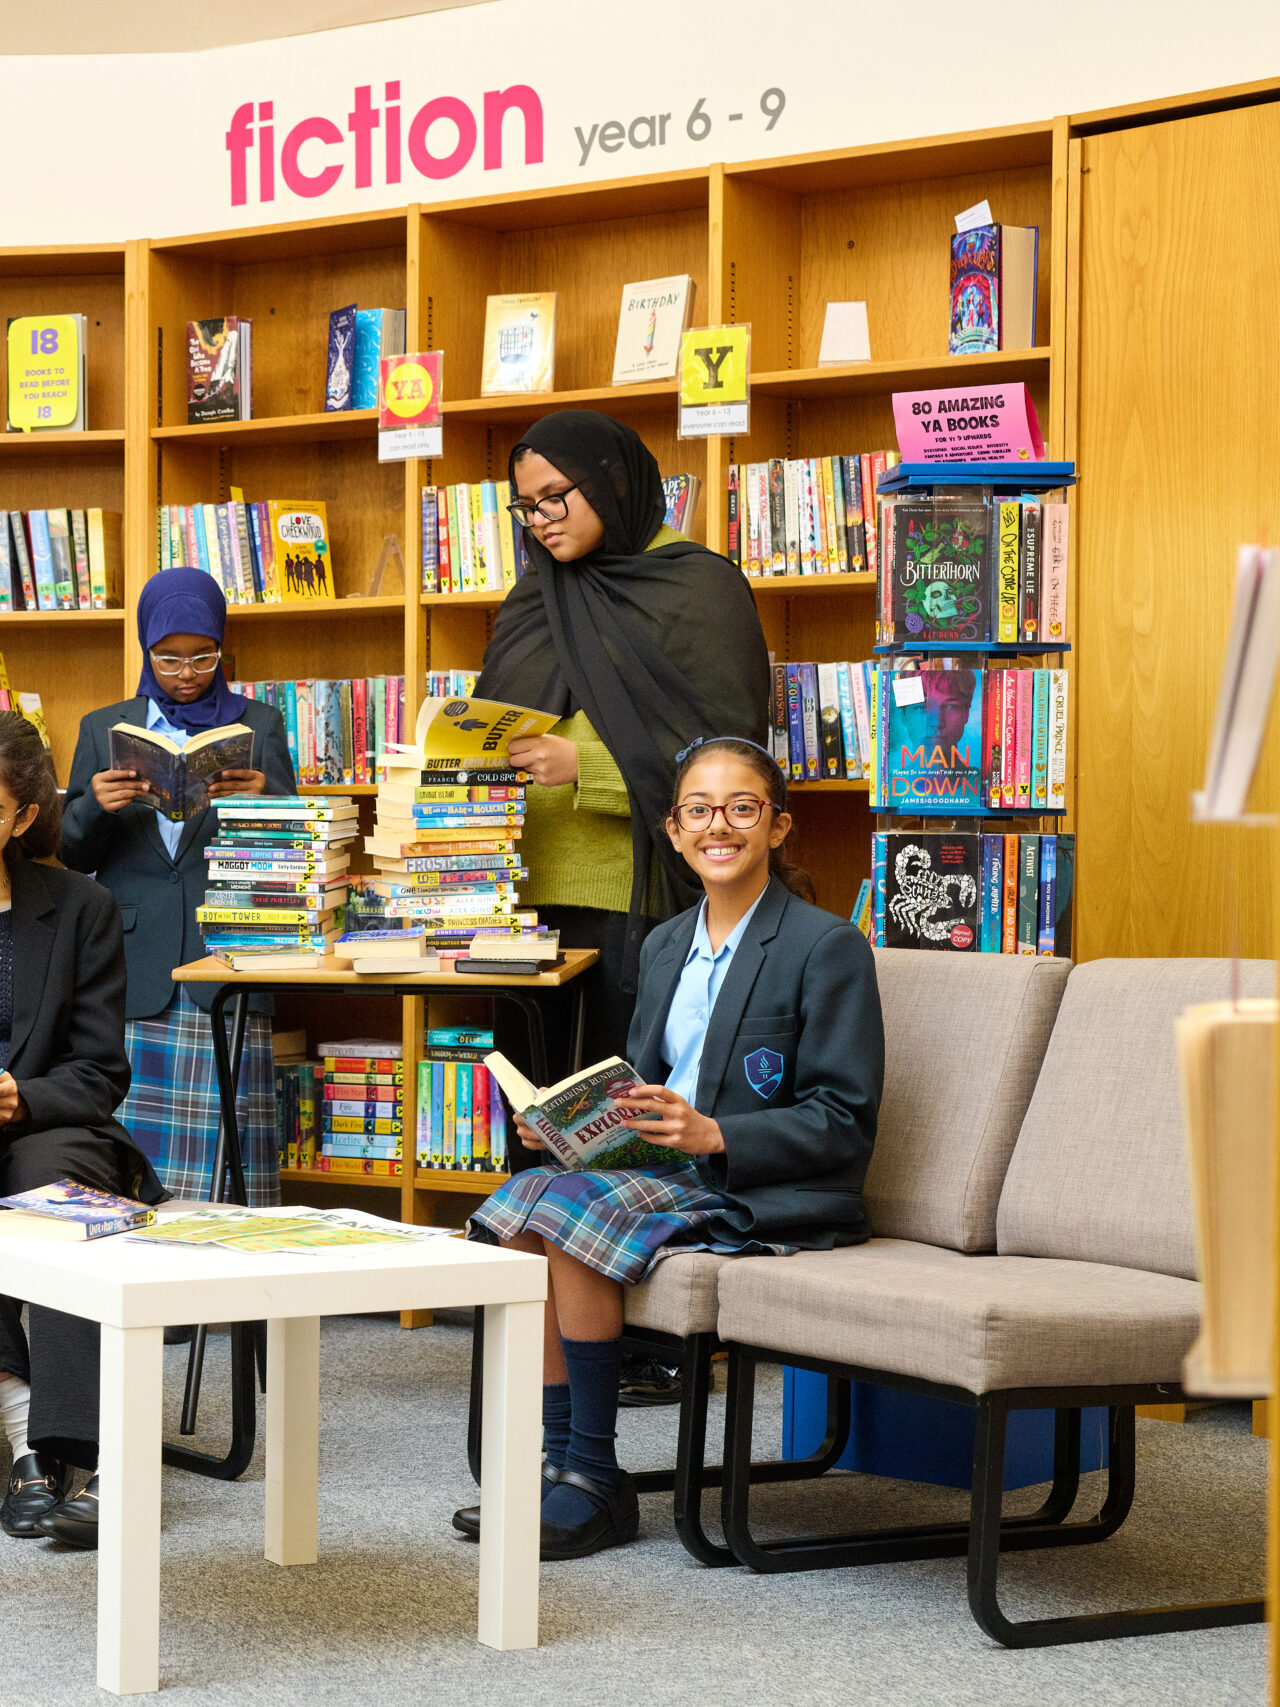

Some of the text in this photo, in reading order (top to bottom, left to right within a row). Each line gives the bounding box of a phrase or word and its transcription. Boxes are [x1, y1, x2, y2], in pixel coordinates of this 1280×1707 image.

[225, 80, 544, 206] fiction
[574, 112, 671, 166] year
[686, 97, 712, 142] 6
[759, 87, 786, 131] 9
[628, 293, 680, 311] BIRTHDAY
[31, 328, 58, 355] 18
[25, 367, 65, 377] BOOKS TO
[694, 345, 733, 389] Y
[20, 379, 70, 389] READ BEFORE
[391, 378, 425, 401] YA
[23, 390, 67, 401] YOU REACH
[912, 394, 1005, 415] 80 AMAZING
[37, 406, 52, 418] 18
[696, 409, 711, 417] Year
[683, 421, 712, 430] everyone
[728, 419, 745, 427] read
[921, 414, 1000, 433] YA BOOKS
[964, 433, 992, 441] UPWARDS
[1003, 548, 1017, 564] THE
[1026, 533, 1035, 594] SUPREME LIE
[900, 560, 981, 586] BITTERTHORN
[1051, 546, 1061, 591] GIRL IN
[1001, 592, 1017, 606] UP
[923, 631, 959, 639] KAT DUNN
[1006, 676, 1016, 686] An
[788, 673, 799, 710] PROUD
[1006, 687, 1016, 709] Island
[776, 701, 785, 726] SONG
[482, 709, 524, 751] BUTTER
[1054, 695, 1065, 754] CRUEL PRINCE
[805, 713, 816, 757] SECRET
[427, 757, 485, 769] BUTTER ERIN
[901, 745, 970, 768] MAN
[477, 773, 499, 782] COLD
[892, 777, 978, 796] DOWN
[422, 804, 505, 815] WE MADE MOLECUL
[218, 861, 249, 870] MAGGOT
[406, 857, 449, 872] FROST
[1026, 845, 1036, 877] ACTIVIST
[990, 884, 999, 914] JUPITER
[203, 911, 261, 921] BOY TOWER
[448, 917, 502, 927] PRINCESS DIARIES
[1007, 907, 1015, 925] DEAD
[952, 935, 971, 944] COPY
[953, 929, 970, 938] Signed
[460, 1036, 493, 1044] DELIRIUM
[543, 1066, 627, 1113] KATHERINE RUNDELL
